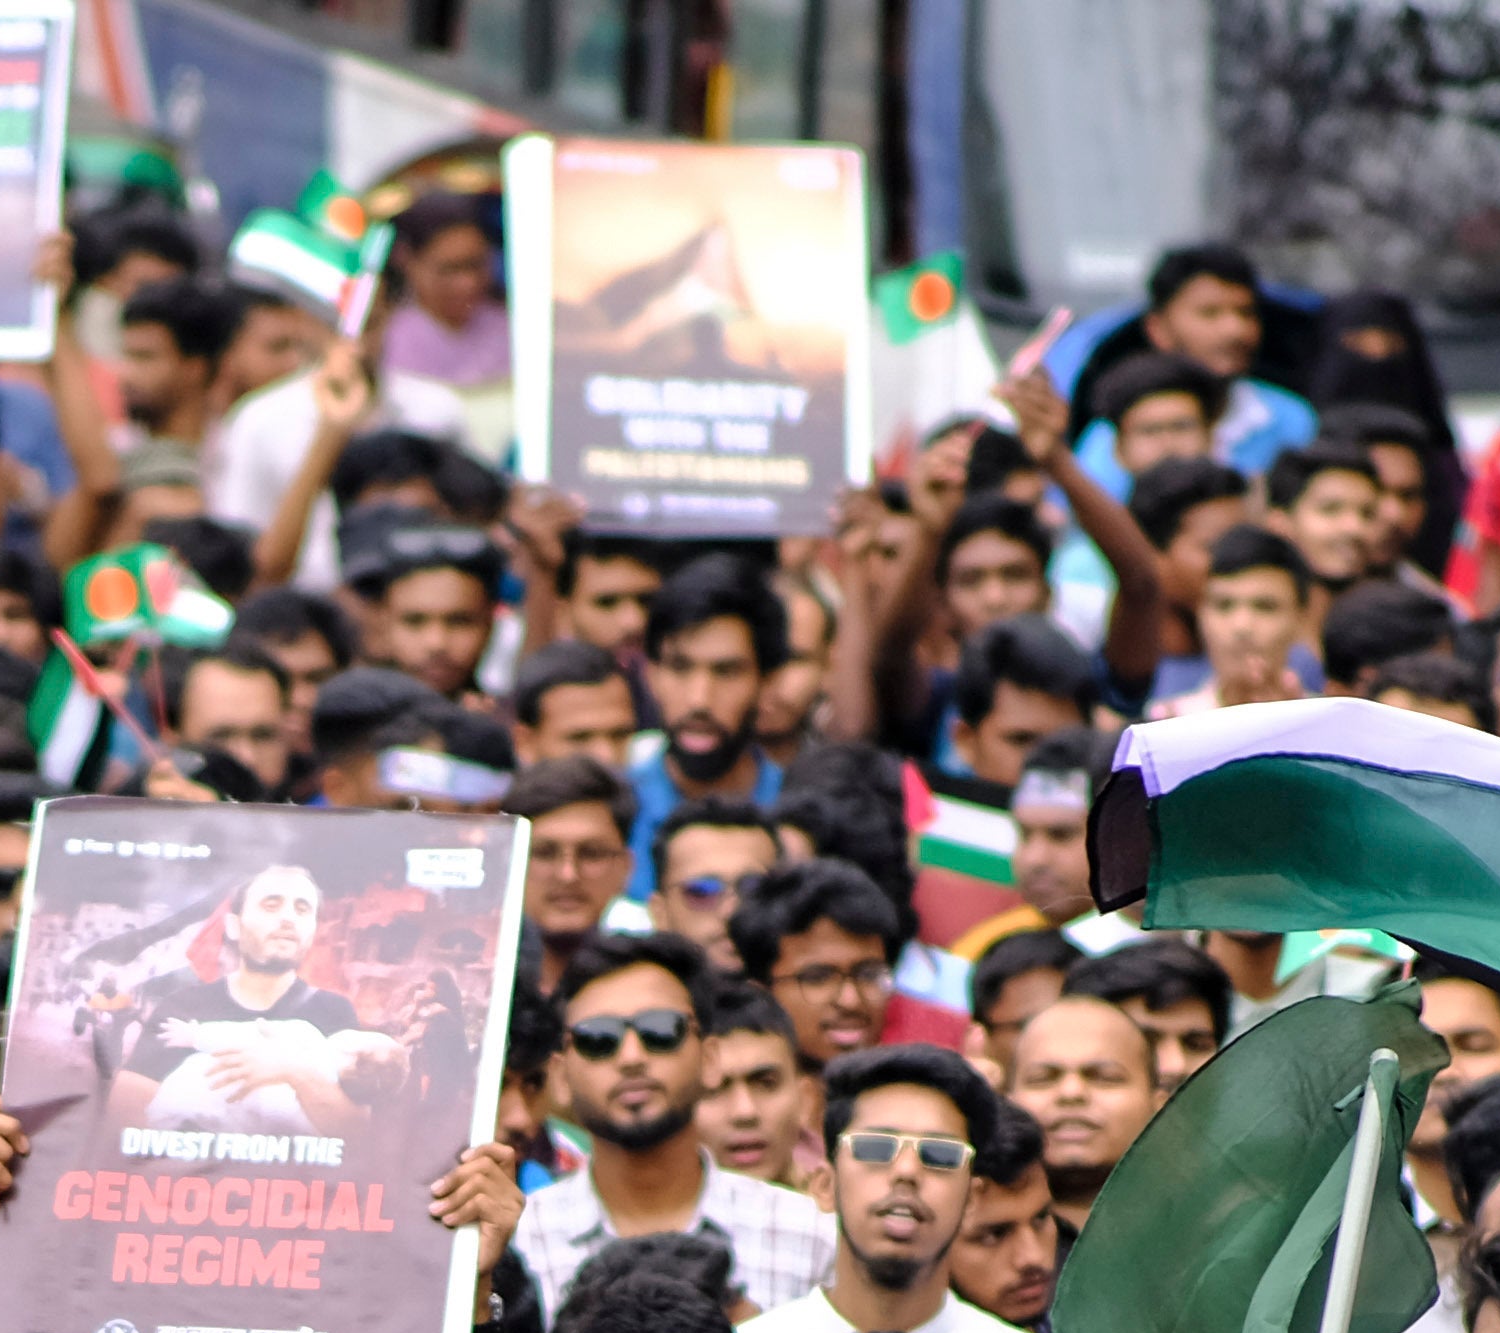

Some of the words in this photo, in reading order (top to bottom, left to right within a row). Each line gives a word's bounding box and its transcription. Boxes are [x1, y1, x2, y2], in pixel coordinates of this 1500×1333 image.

[121, 1127, 214, 1161] DIVEST
[215, 1131, 291, 1165] FROM
[293, 1135, 344, 1166] THE
[52, 1169, 395, 1233] GENOCIDIAL
[111, 1232, 326, 1290] REGIME
